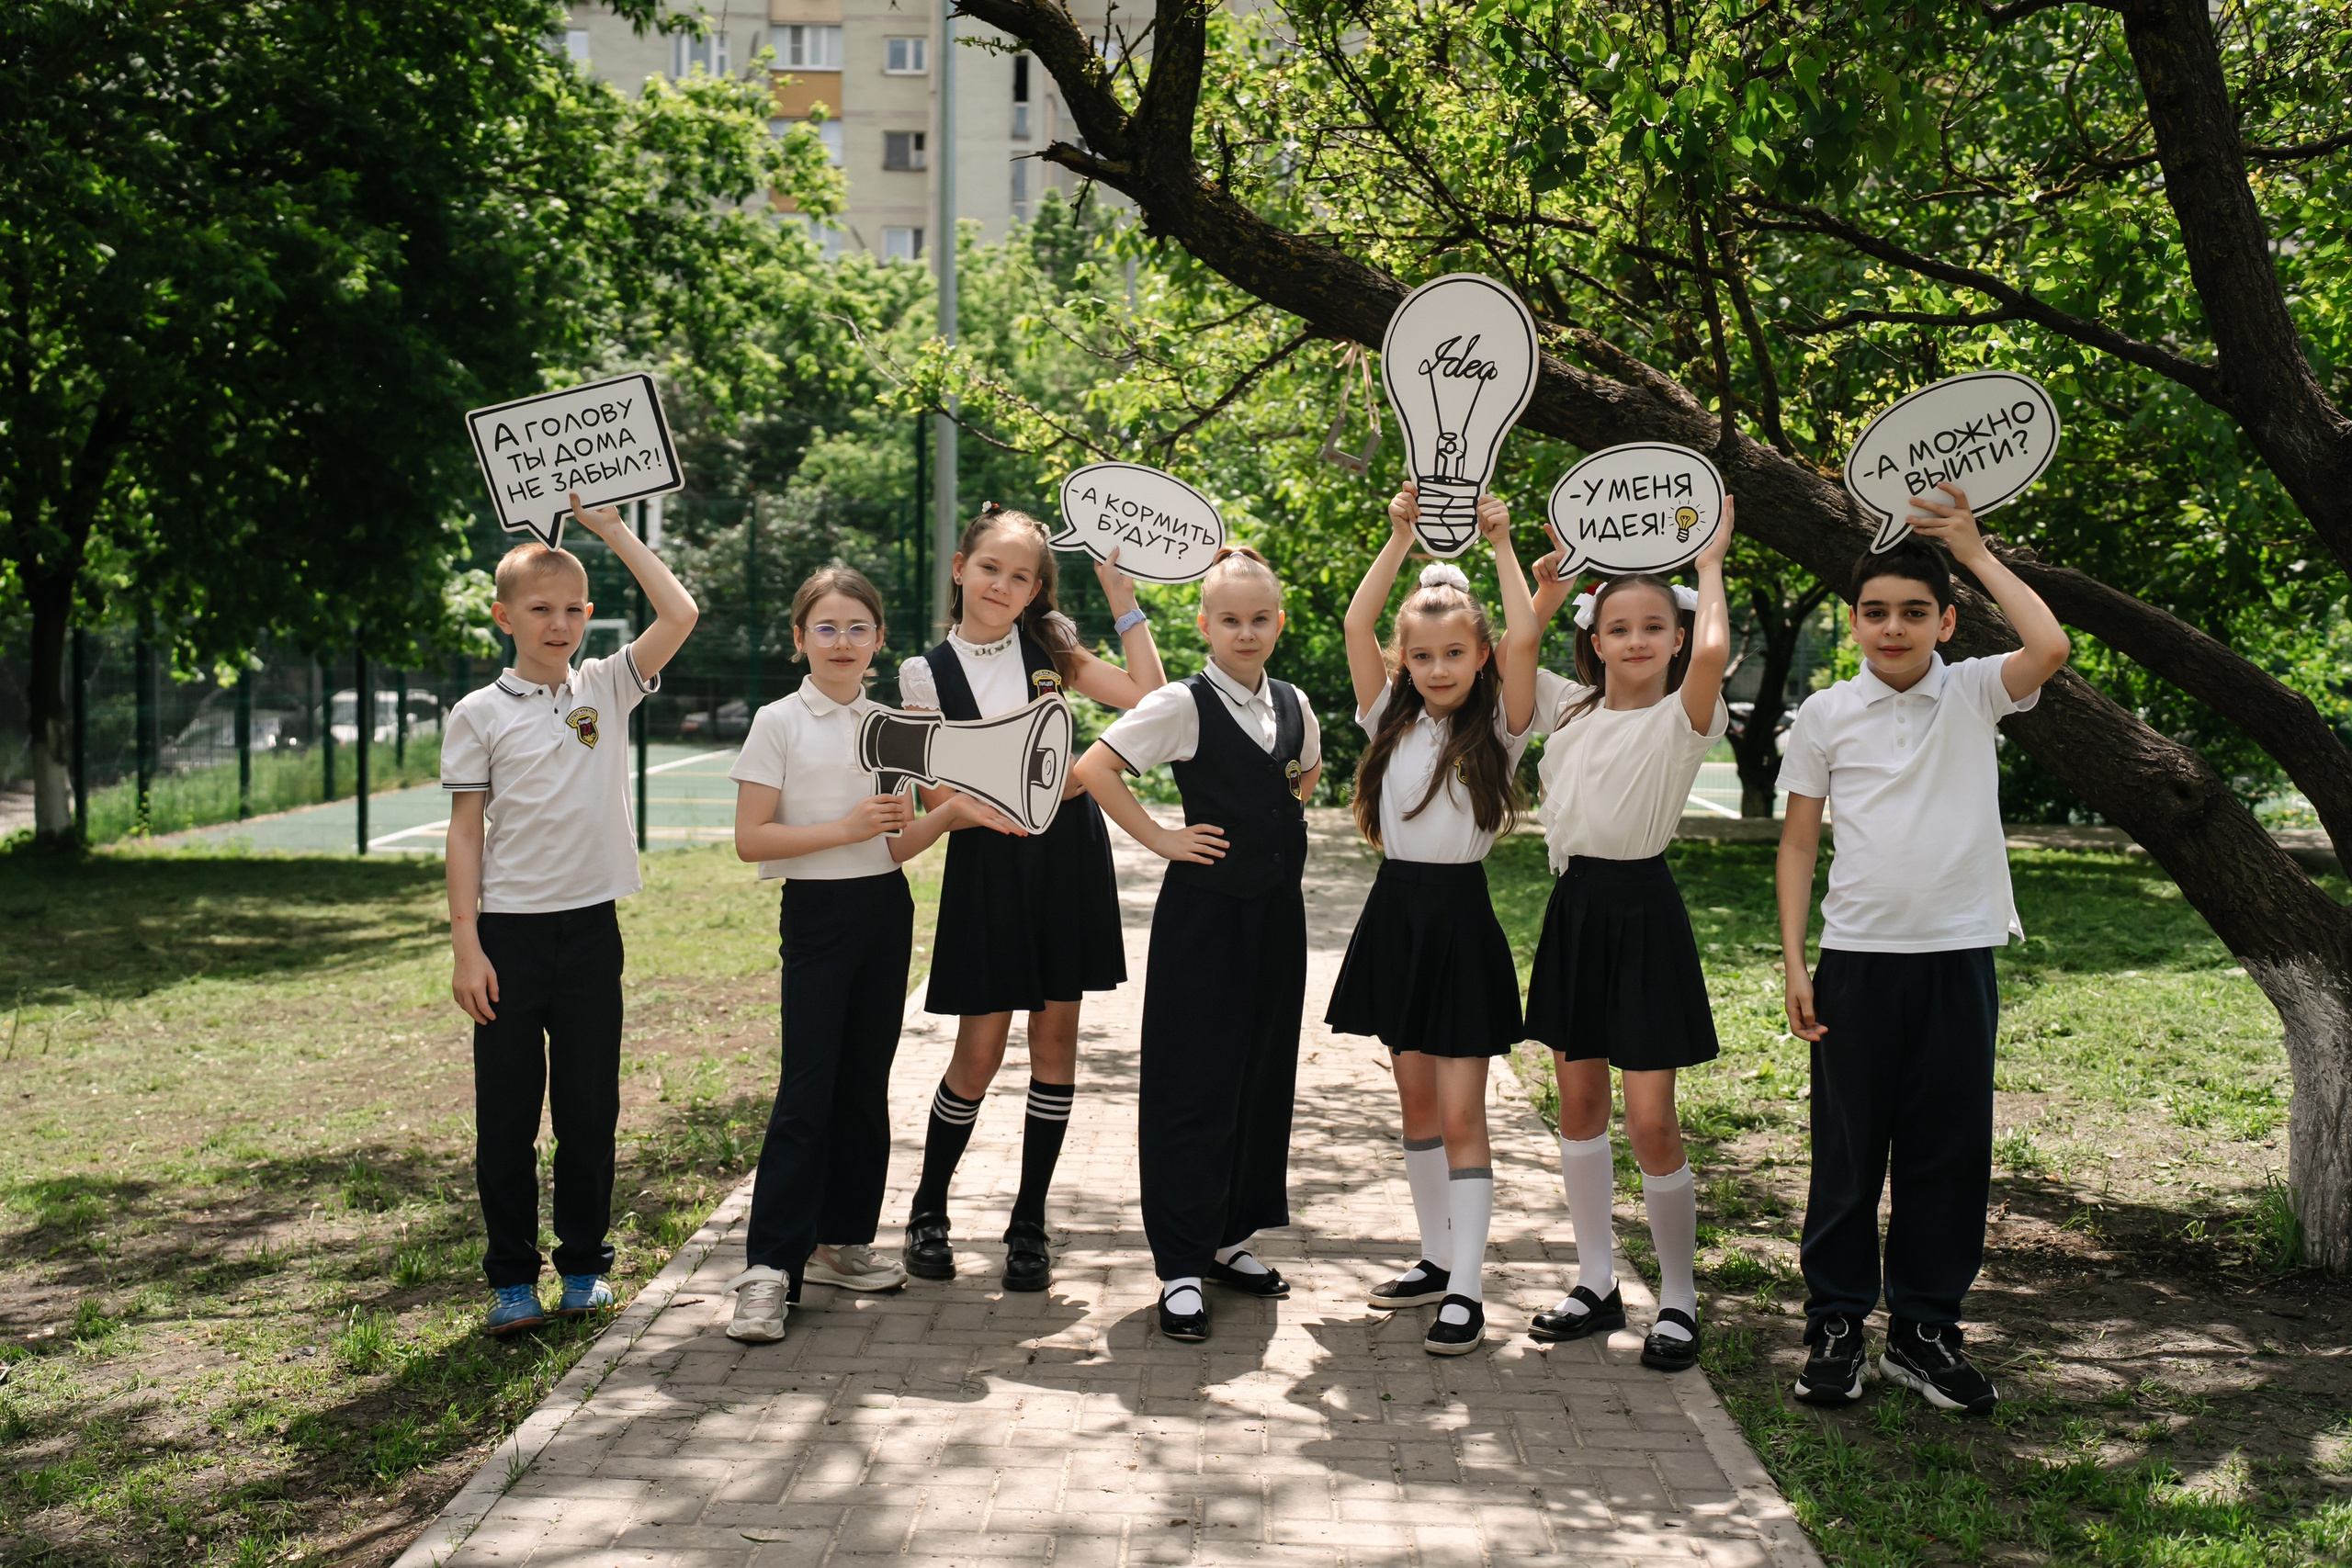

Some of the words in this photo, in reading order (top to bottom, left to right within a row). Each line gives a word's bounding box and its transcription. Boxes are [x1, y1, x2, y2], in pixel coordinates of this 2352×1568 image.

[1418, 333, 1498, 381] Idea
[494, 423, 520, 452] А
[525, 398, 633, 443] ГОЛОВУ
[1909, 400, 2035, 468] МОЖНО
[506, 447, 547, 474] ТЫ
[554, 427, 637, 468] ДОМА
[1904, 429, 2029, 496] ВЫЙТИ?
[506, 477, 545, 504] НЕ
[550, 447, 662, 492] ЗАБЫЛ?!
[1608, 472, 1692, 502] МЕНЯ
[1097, 513, 1190, 560] БУДУТ?
[1105, 493, 1216, 546] КОРМИТЬ
[1579, 511, 1666, 543] ИДЕЯ!
[582, 724, 592, 735] 27
